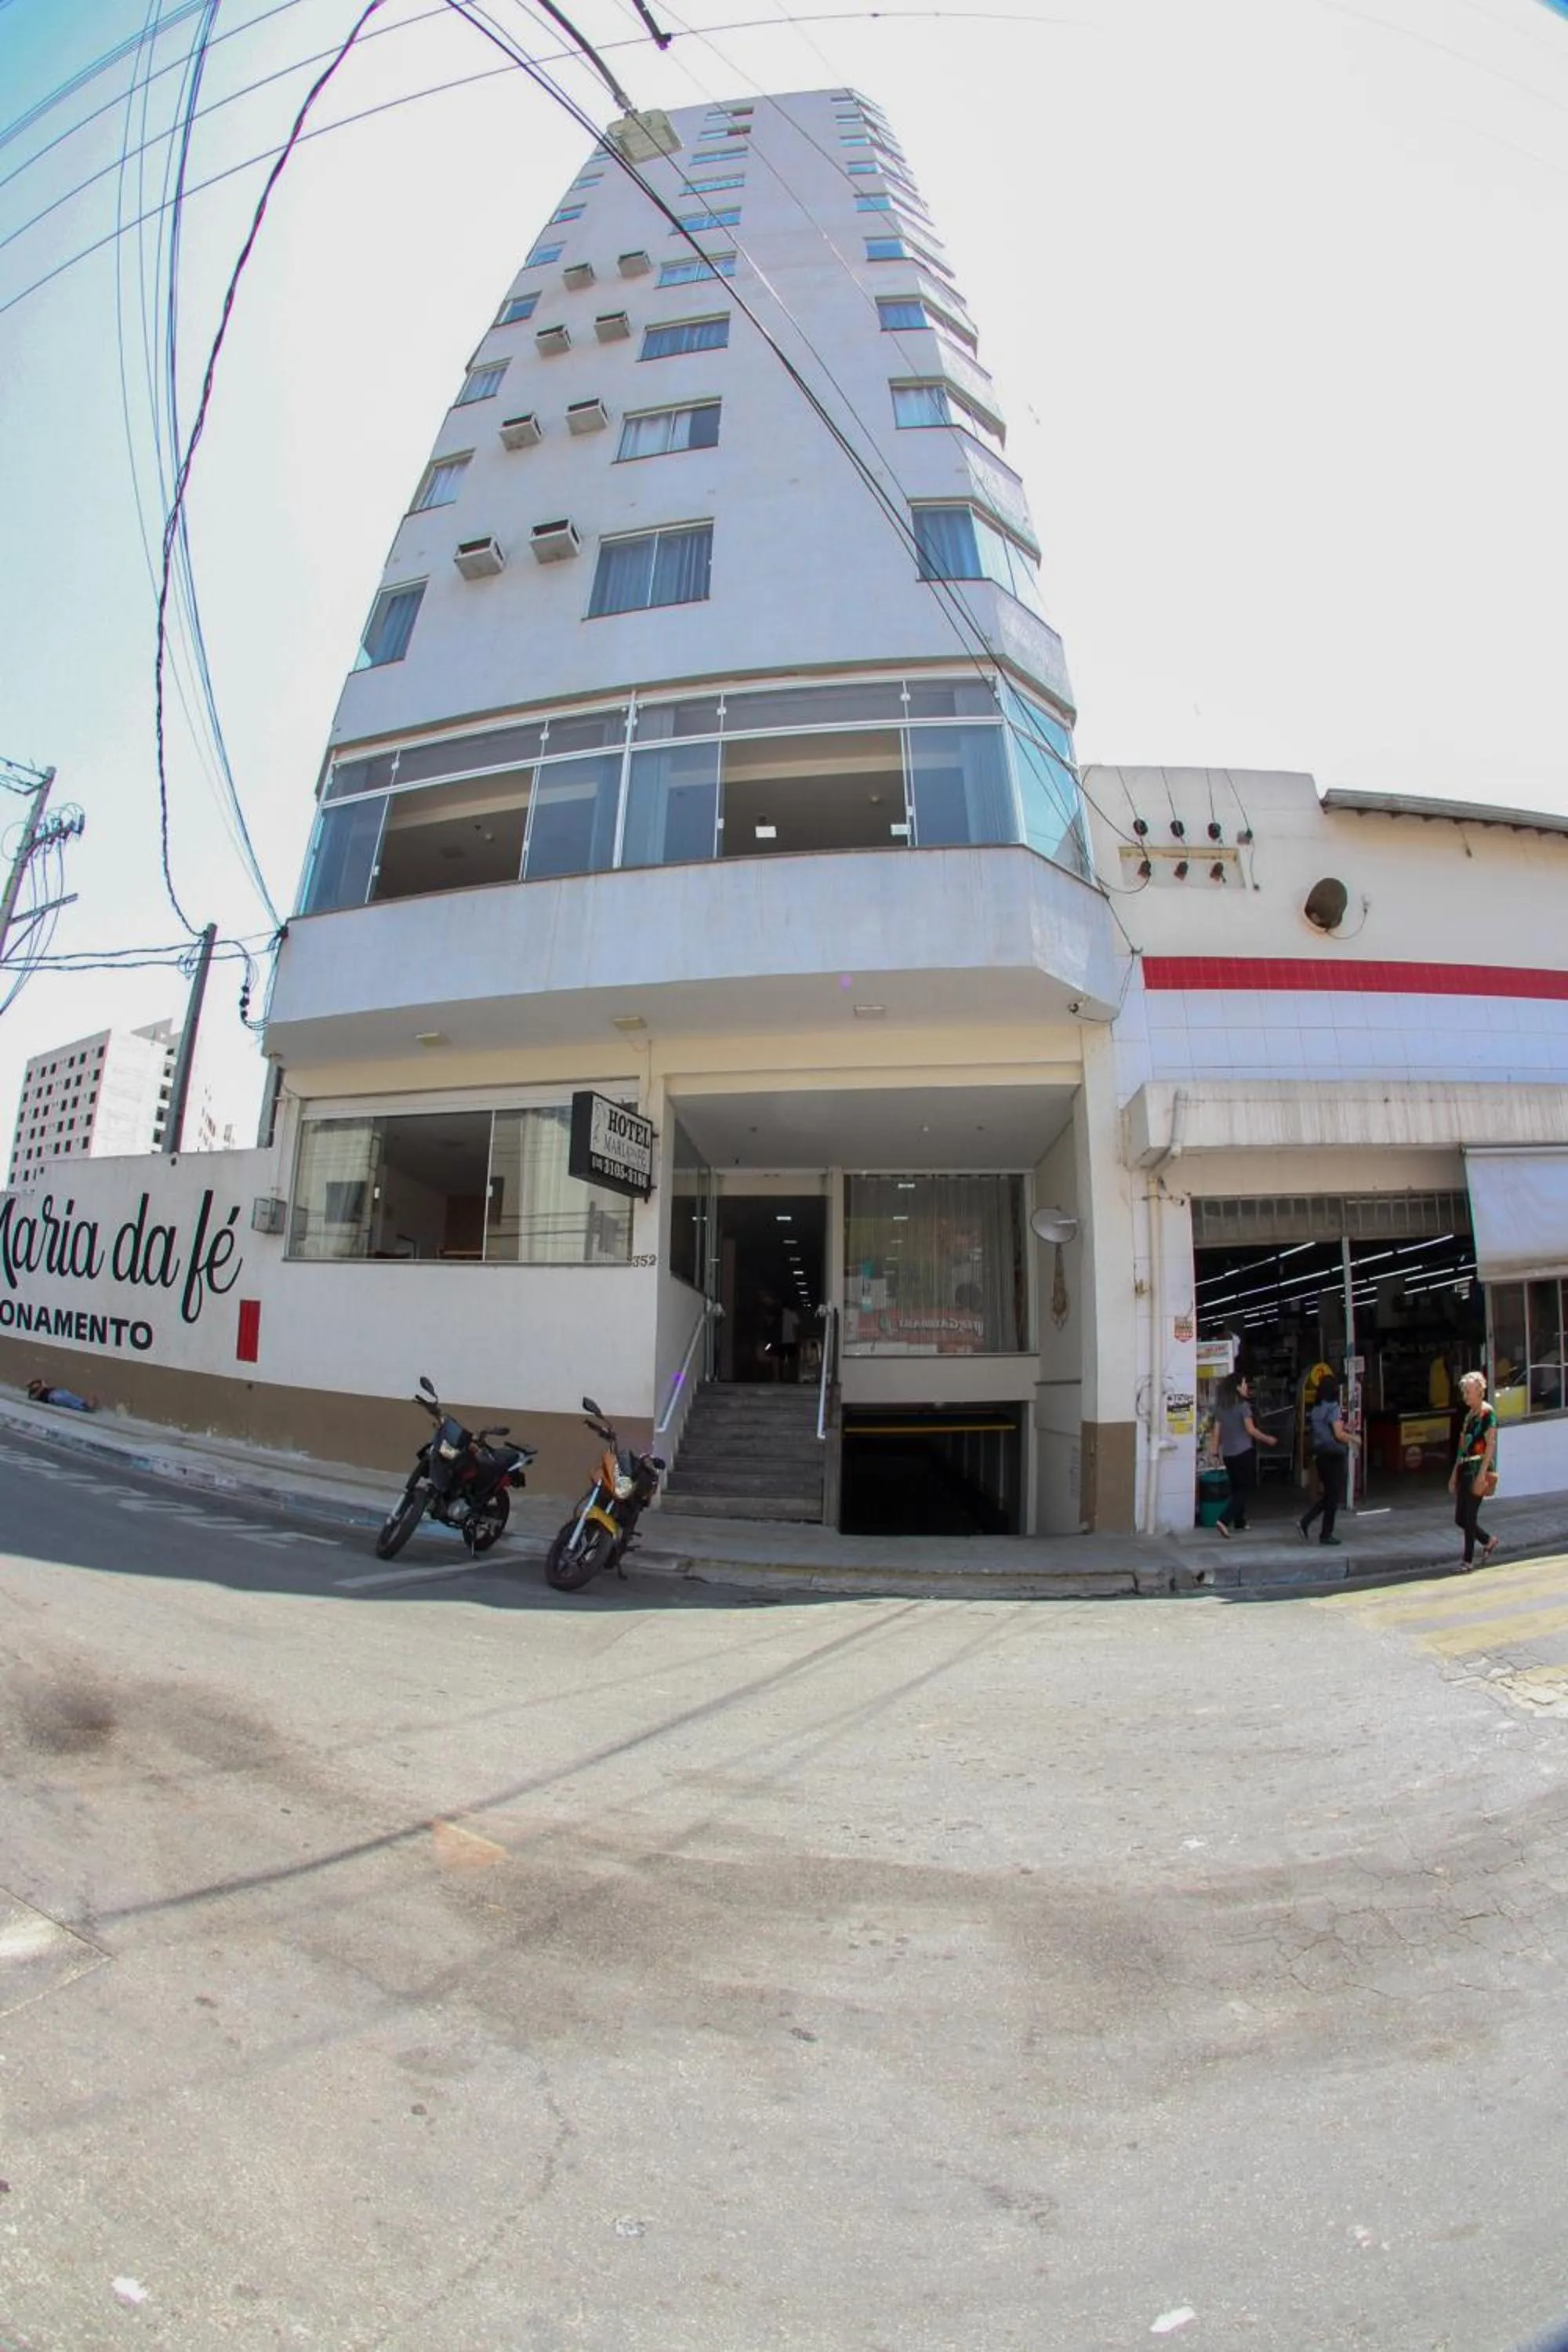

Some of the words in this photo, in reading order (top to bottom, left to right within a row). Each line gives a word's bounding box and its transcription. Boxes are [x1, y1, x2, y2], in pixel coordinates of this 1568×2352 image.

[608, 1109, 650, 1149] HOTEL
[112, 1192, 180, 1289] da
[181, 1189, 244, 1324] fé
[0, 1298, 154, 1350] ONAMENTO
